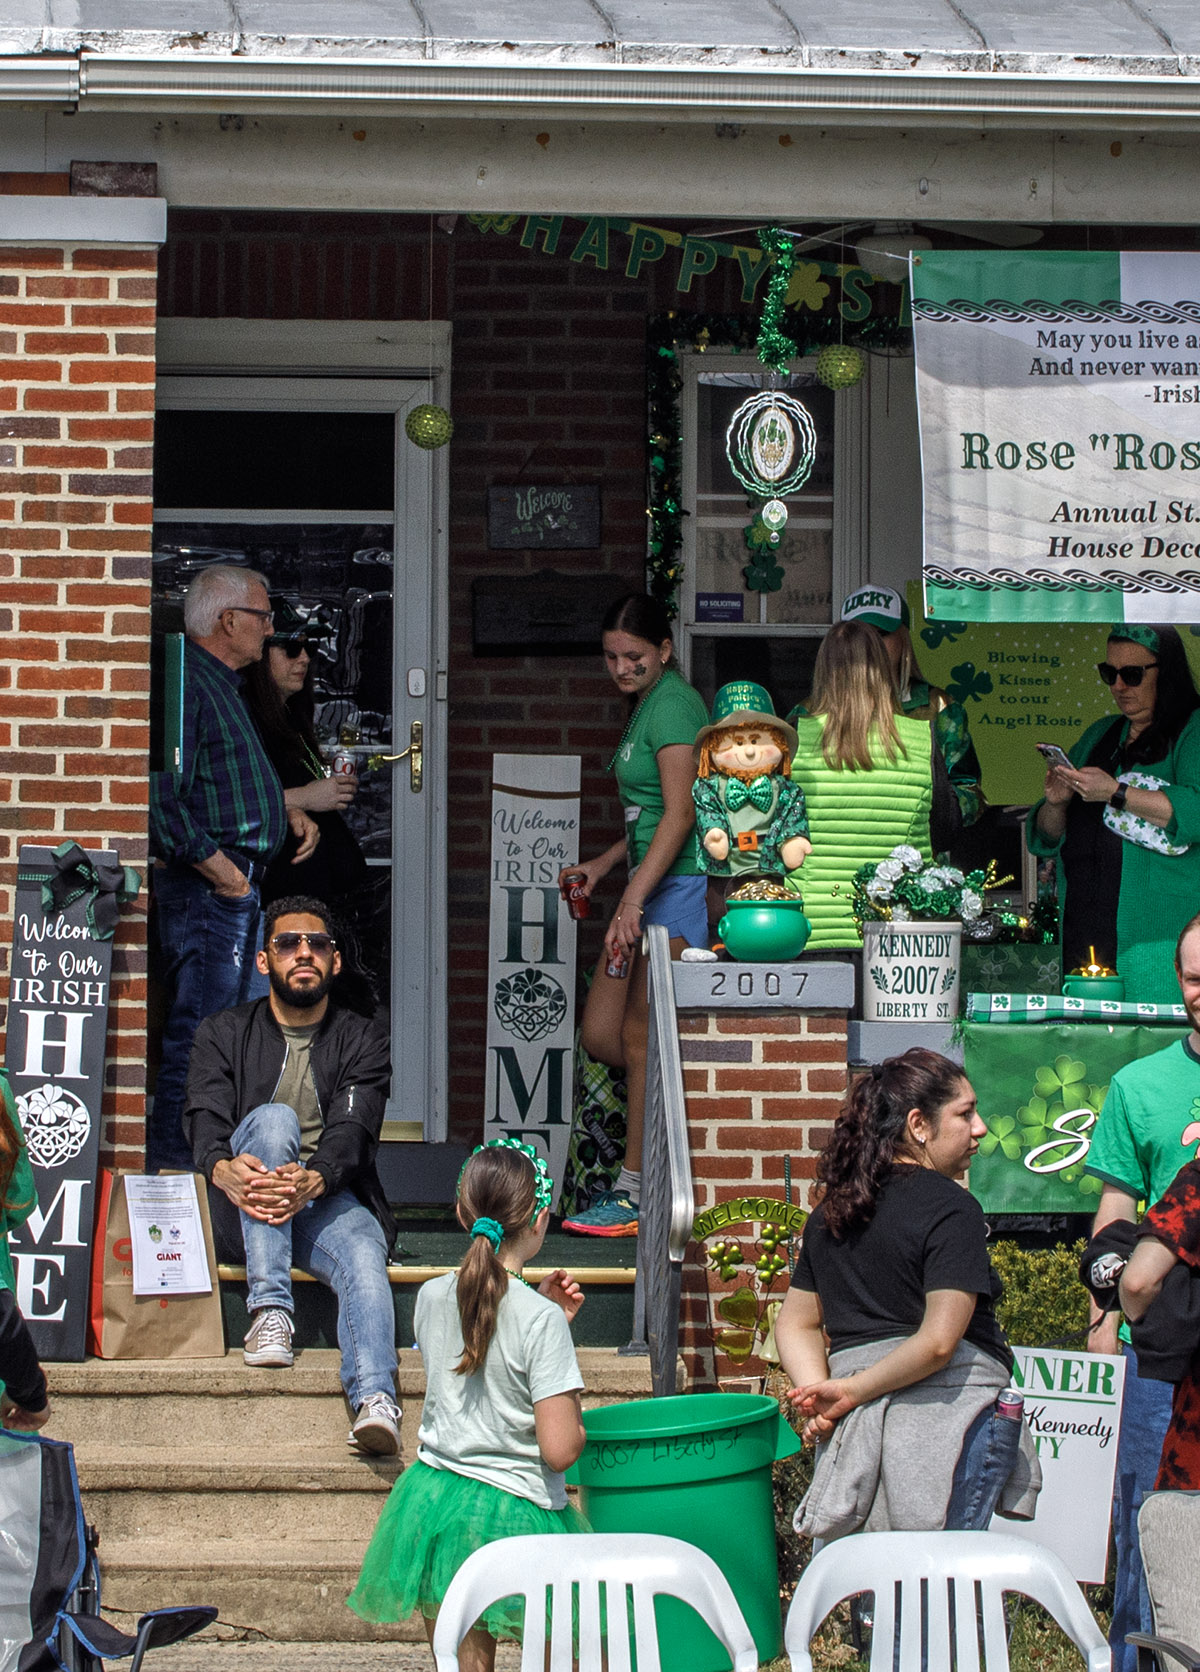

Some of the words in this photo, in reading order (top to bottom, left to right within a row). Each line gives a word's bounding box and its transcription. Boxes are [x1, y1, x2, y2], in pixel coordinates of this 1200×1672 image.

[1037, 330, 1085, 353] May
[1090, 335, 1132, 353] you
[1139, 330, 1179, 349] live
[1029, 357, 1073, 376] And
[1080, 362, 1145, 376] never
[960, 433, 1076, 471] Rose
[1049, 501, 1157, 523] Annual
[1166, 501, 1200, 524] St.
[1047, 537, 1133, 559] House
[699, 600, 709, 608] NO
[709, 600, 741, 608] SOLICITING
[844, 590, 893, 615] LUCKY
[987, 651, 1061, 667] Blowing
[999, 673, 1051, 686] Kisses
[999, 693, 1017, 704] to
[1020, 695, 1050, 704] our
[978, 714, 1032, 730] Angel
[1036, 714, 1082, 727] Rosie
[494, 808, 577, 835] Welcome
[503, 840, 523, 857] to
[527, 837, 569, 859] Our
[879, 935, 951, 957] KENNEDY
[22, 948, 51, 976] to
[58, 951, 103, 978] Our
[12, 977, 106, 1007] IRISH
[711, 972, 809, 996] 2007
[892, 966, 939, 995] 2007
[876, 1002, 928, 1018] LIBERTY
[936, 1003, 950, 1018] ST.
[692, 1199, 805, 1236] WELCOME
[156, 1253, 182, 1261] GIANT
[1024, 1405, 1114, 1448] Kennedy
[590, 1441, 639, 1472] 2007
[653, 1434, 717, 1462] Liberty
